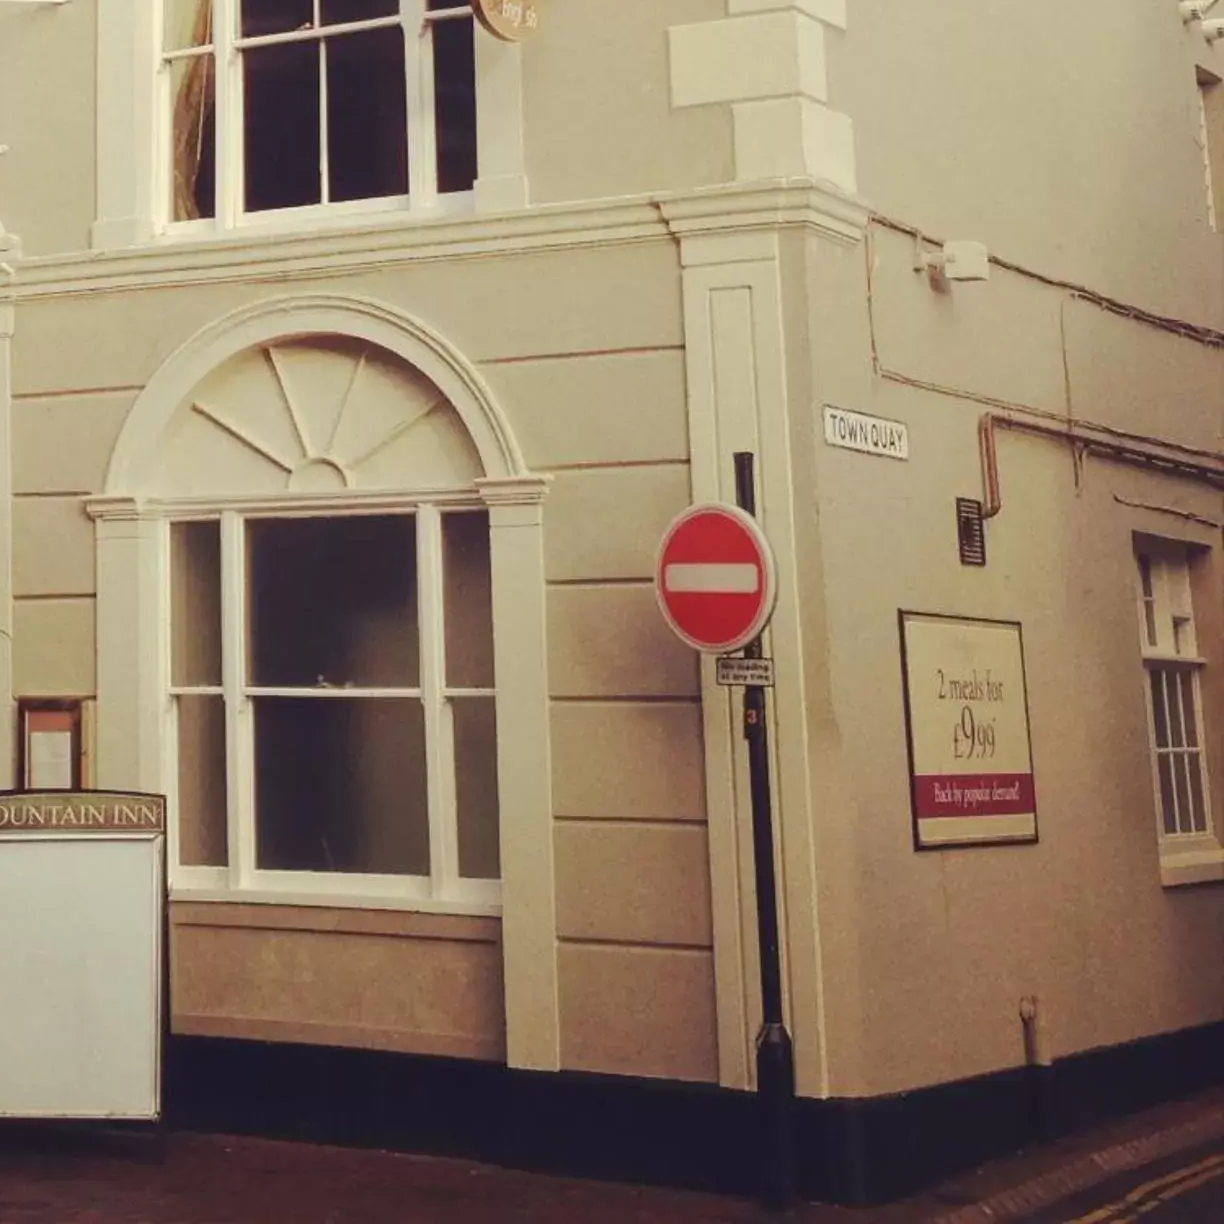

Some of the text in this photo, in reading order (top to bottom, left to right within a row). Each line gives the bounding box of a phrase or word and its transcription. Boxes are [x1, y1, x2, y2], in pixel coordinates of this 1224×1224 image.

[829, 413, 903, 453] TOWN QUAY
[937, 669, 1004, 702] 2 meals for
[114, 804, 158, 826] INN
